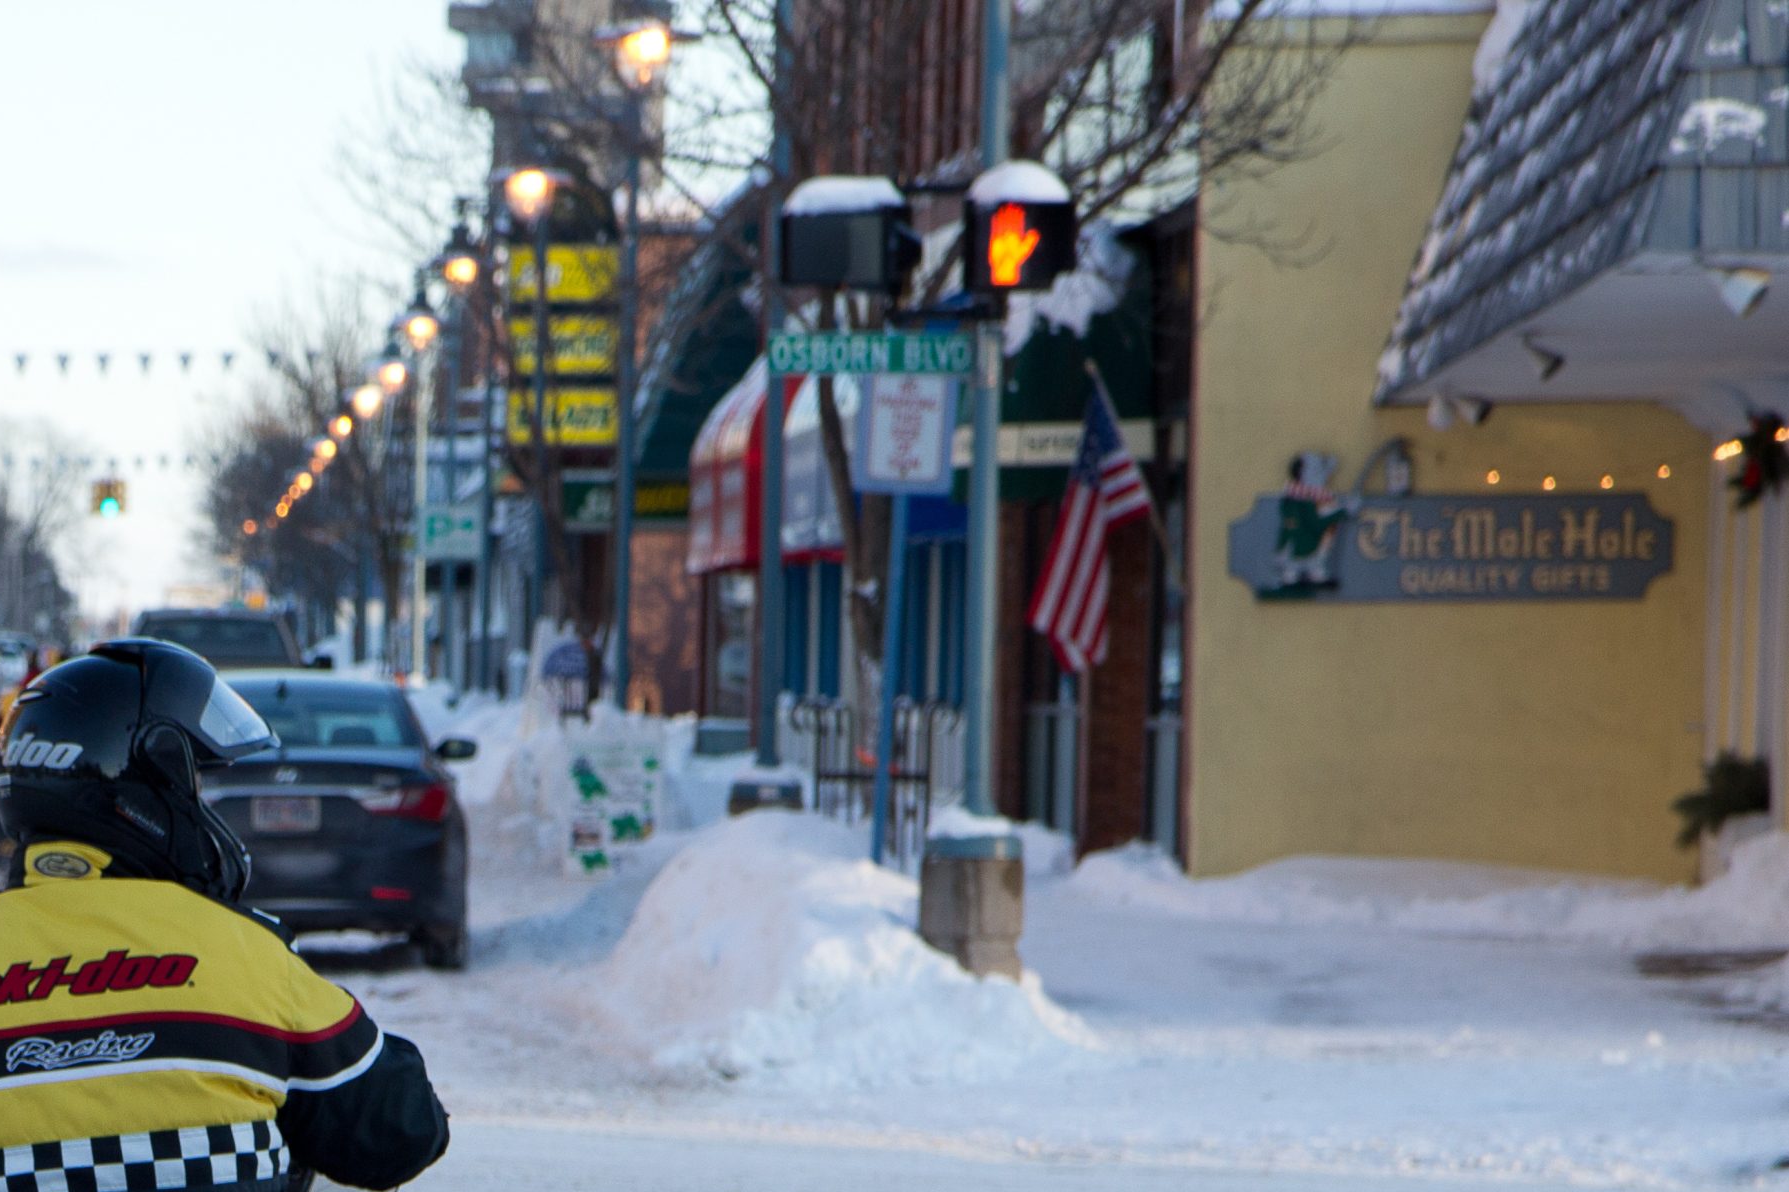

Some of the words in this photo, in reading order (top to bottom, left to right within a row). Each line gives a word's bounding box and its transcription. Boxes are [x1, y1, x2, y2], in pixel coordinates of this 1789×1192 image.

[771, 334, 888, 372] OSBORN
[903, 335, 972, 372] BLVD
[1358, 507, 1444, 560] The
[1447, 506, 1554, 560] Mole
[1562, 506, 1656, 560] Hole
[1400, 563, 1522, 594] QUALITY
[1531, 563, 1610, 593] GIFTS
[5, 1029, 155, 1073] Racing
